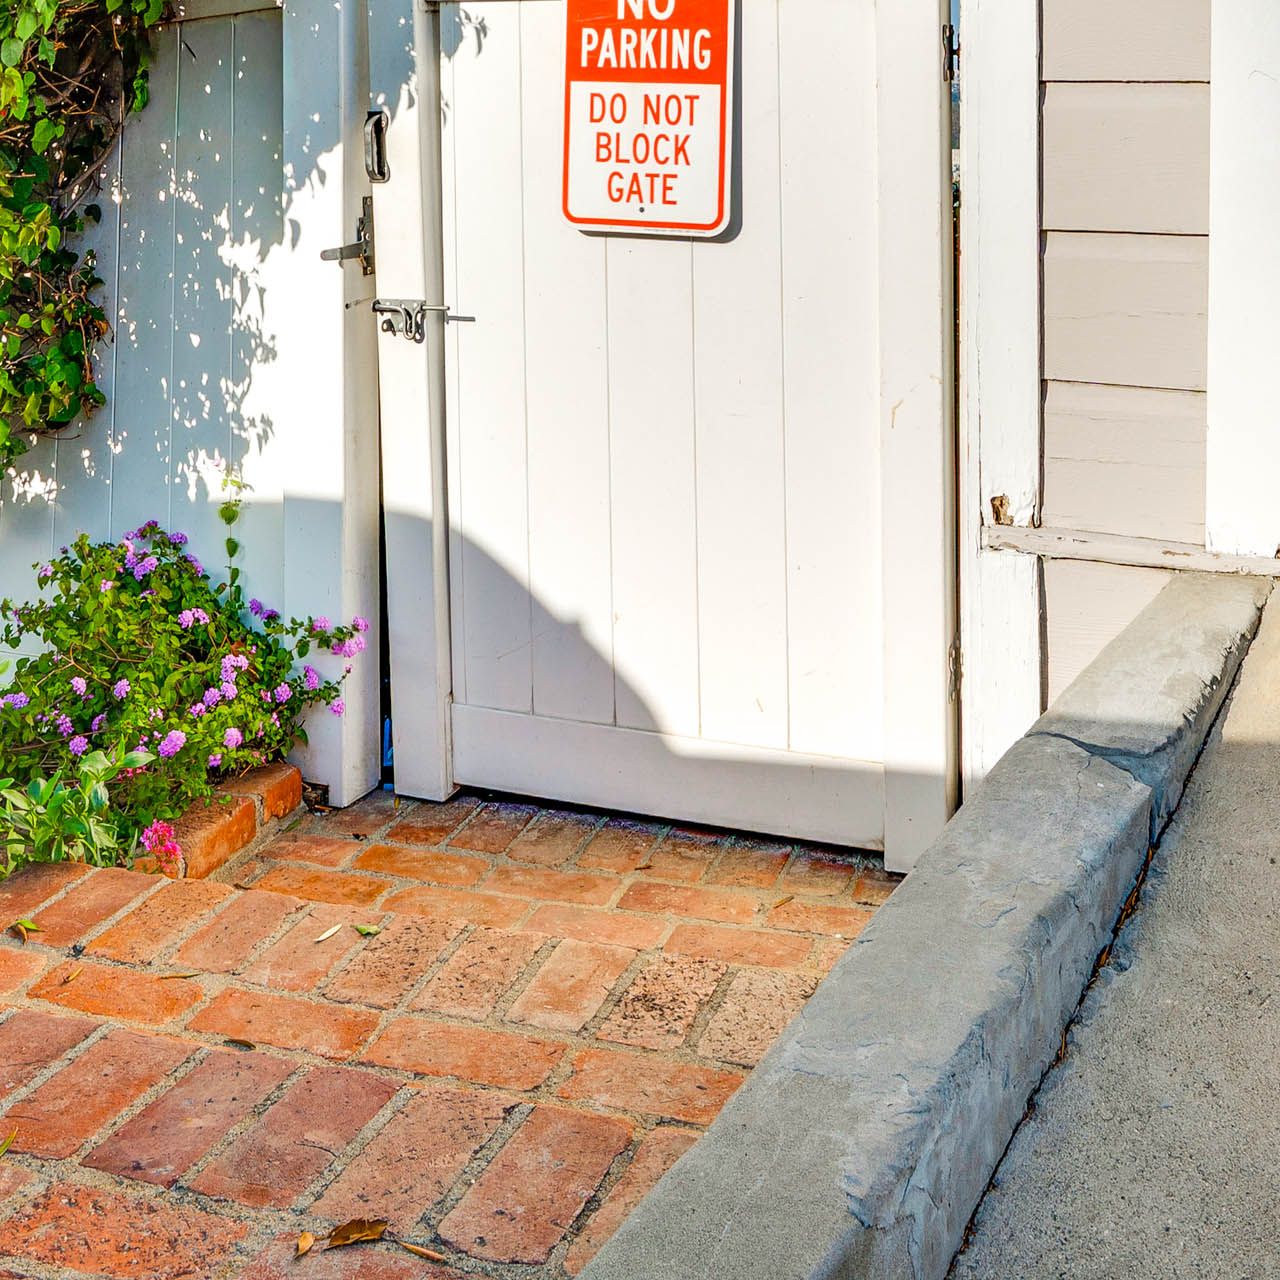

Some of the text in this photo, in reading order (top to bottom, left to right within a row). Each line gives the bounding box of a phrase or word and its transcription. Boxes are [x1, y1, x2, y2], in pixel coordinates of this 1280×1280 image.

[580, 28, 712, 70] PARKING
[589, 92, 700, 126] DO NOT
[595, 132, 691, 166] BLOCK
[607, 171, 678, 205] GATE
